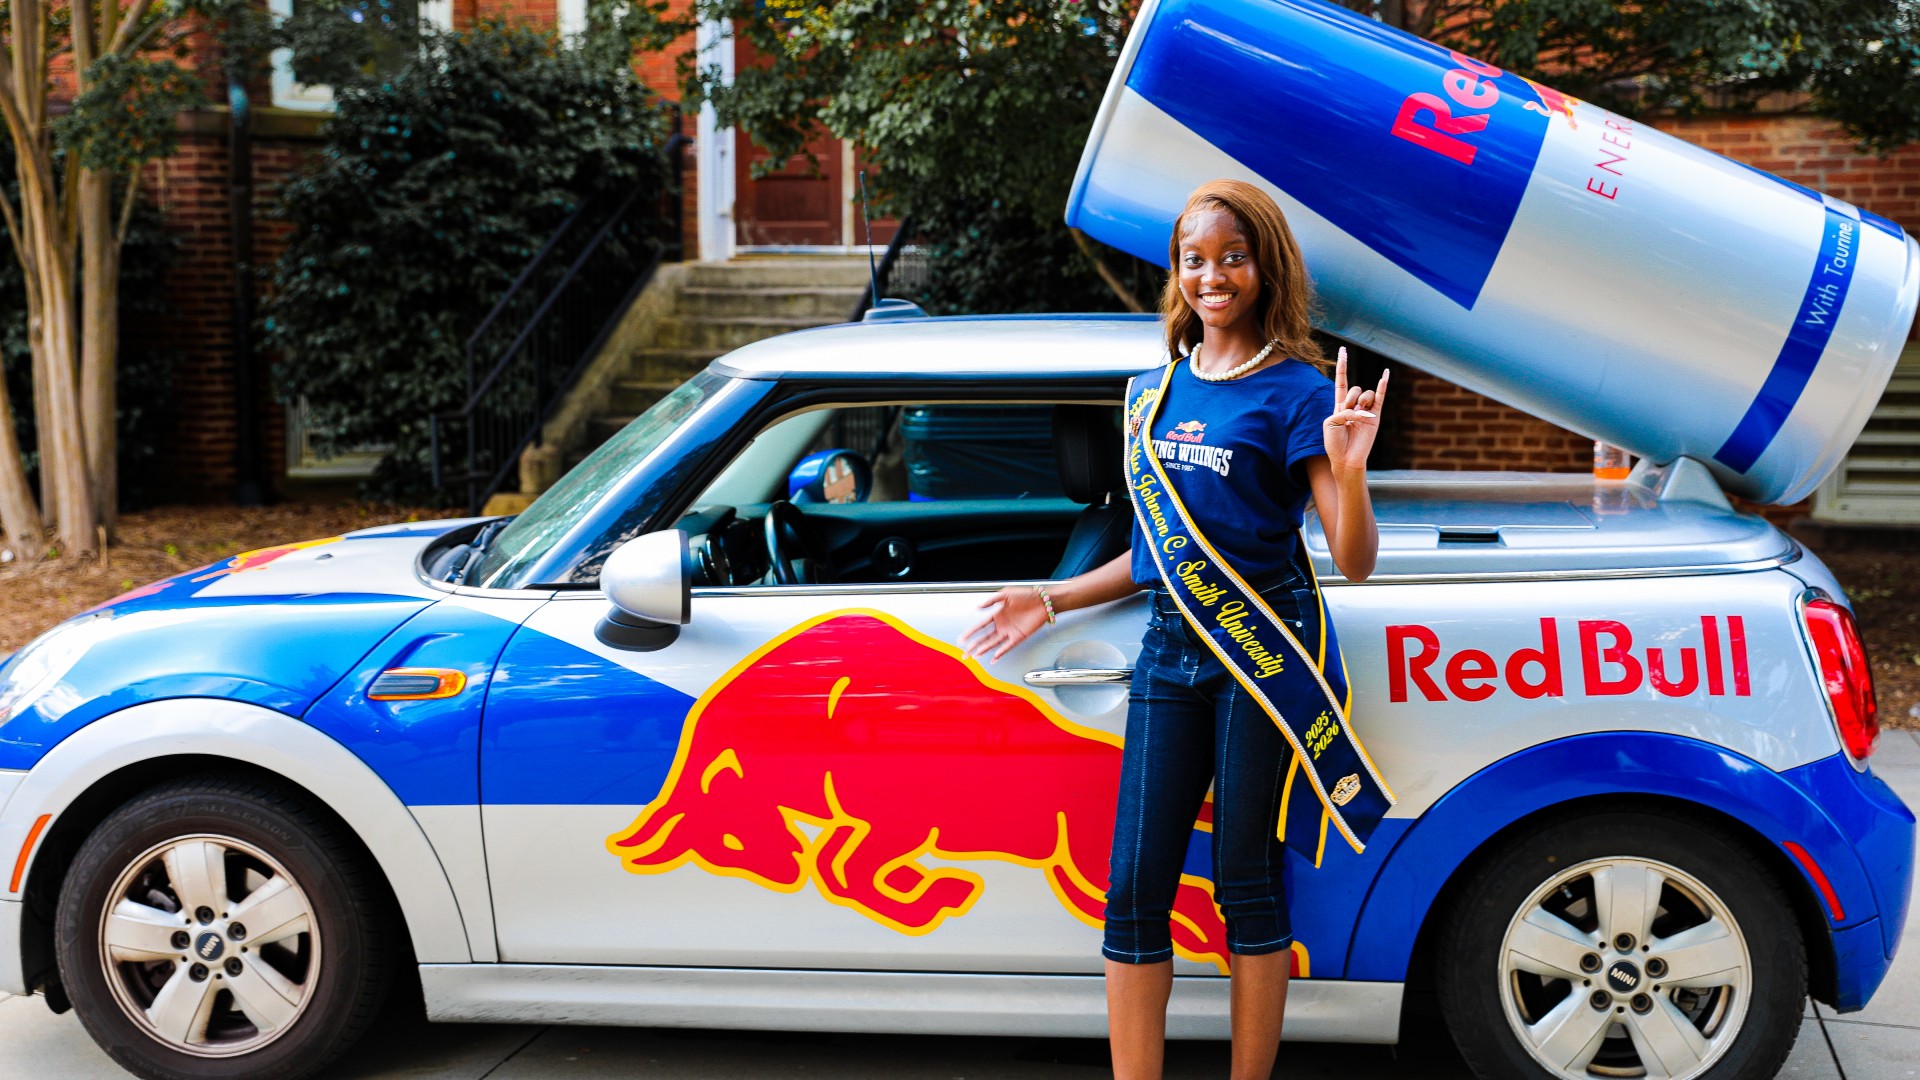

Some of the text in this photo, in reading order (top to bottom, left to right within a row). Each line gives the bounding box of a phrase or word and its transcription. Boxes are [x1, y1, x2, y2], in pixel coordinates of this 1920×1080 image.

[1586, 110, 1633, 200] ENER
[1805, 283, 1839, 325] With
[1133, 473, 1170, 537] Johnson
[1163, 536, 1189, 561] C.
[1176, 560, 1228, 607] Smith
[1215, 600, 1285, 679] University
[1385, 615, 1752, 703] Red Bull
[1313, 720, 1340, 761] 2026
[200, 935, 220, 958] MINI
[1610, 967, 1637, 987] MINI
